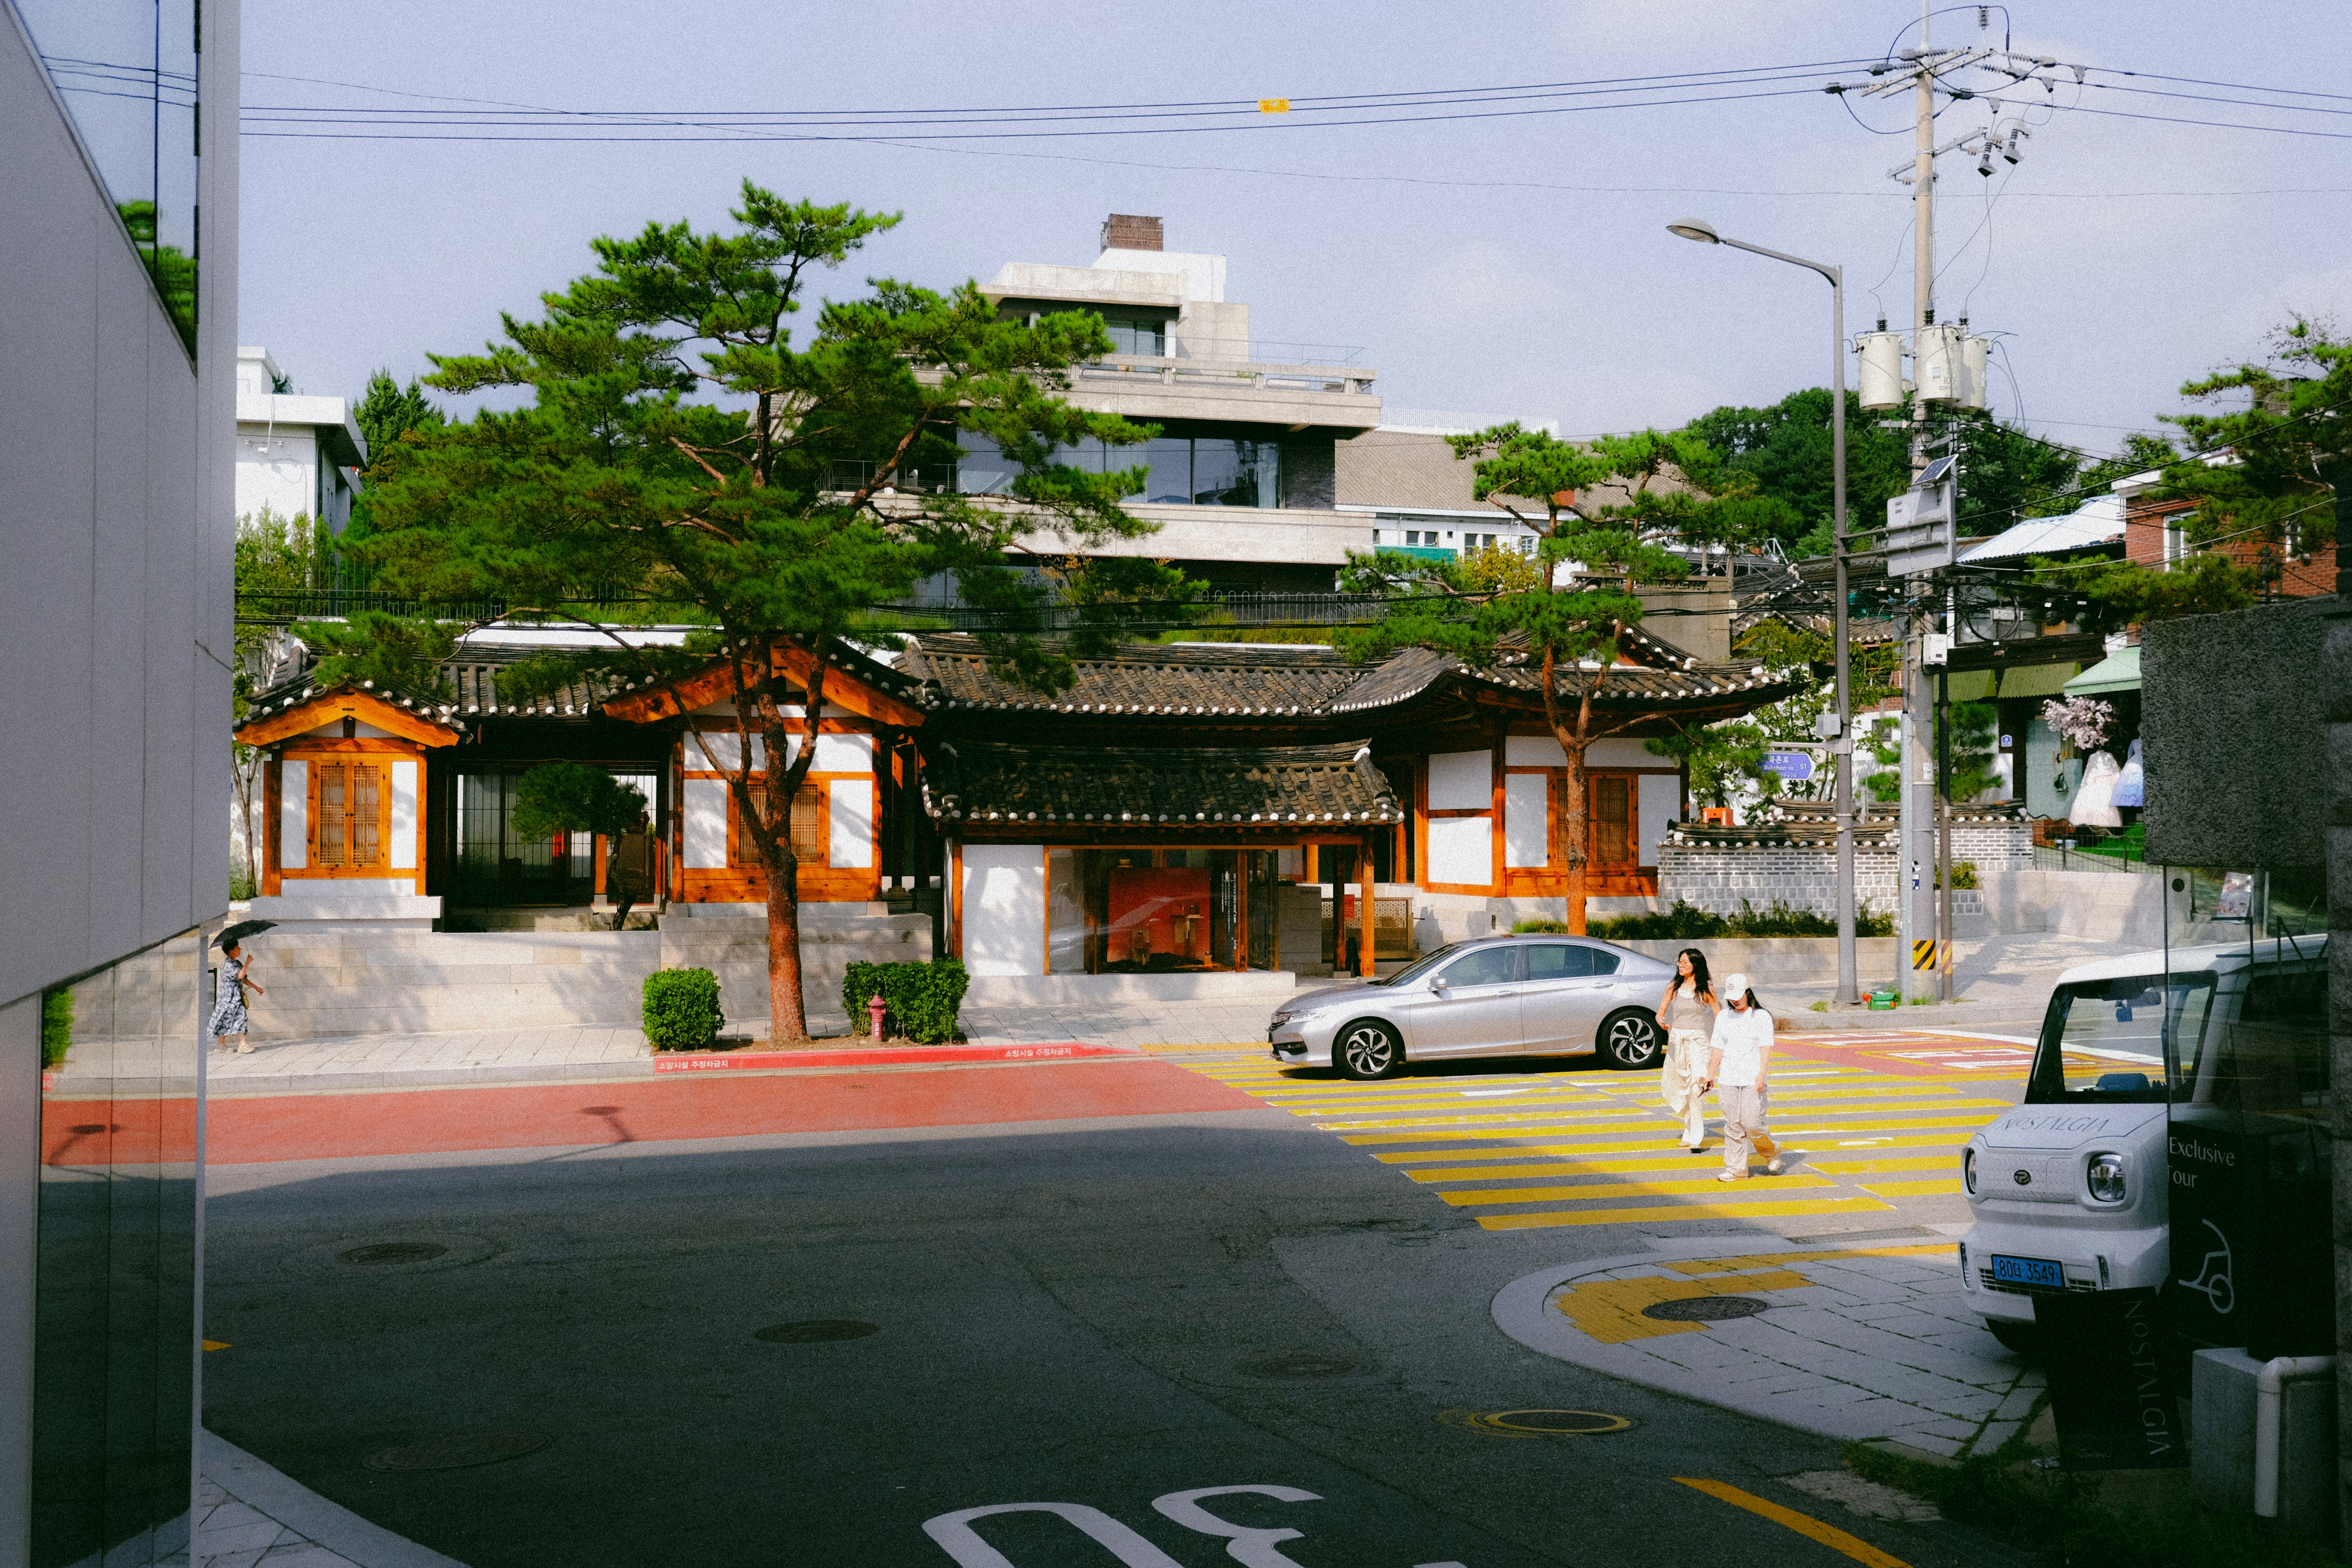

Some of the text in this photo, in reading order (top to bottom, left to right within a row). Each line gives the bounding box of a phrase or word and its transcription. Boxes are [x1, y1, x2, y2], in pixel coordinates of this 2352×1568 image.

[691, 1060, 728, 1068] 주정차금지
[1998, 1116, 2110, 1132] NOSTALGIA
[2169, 1136, 2235, 1166] Exclusive
[2026, 1263, 2055, 1283] 3549
[2121, 1300, 2171, 1456] NOSTALGIA
